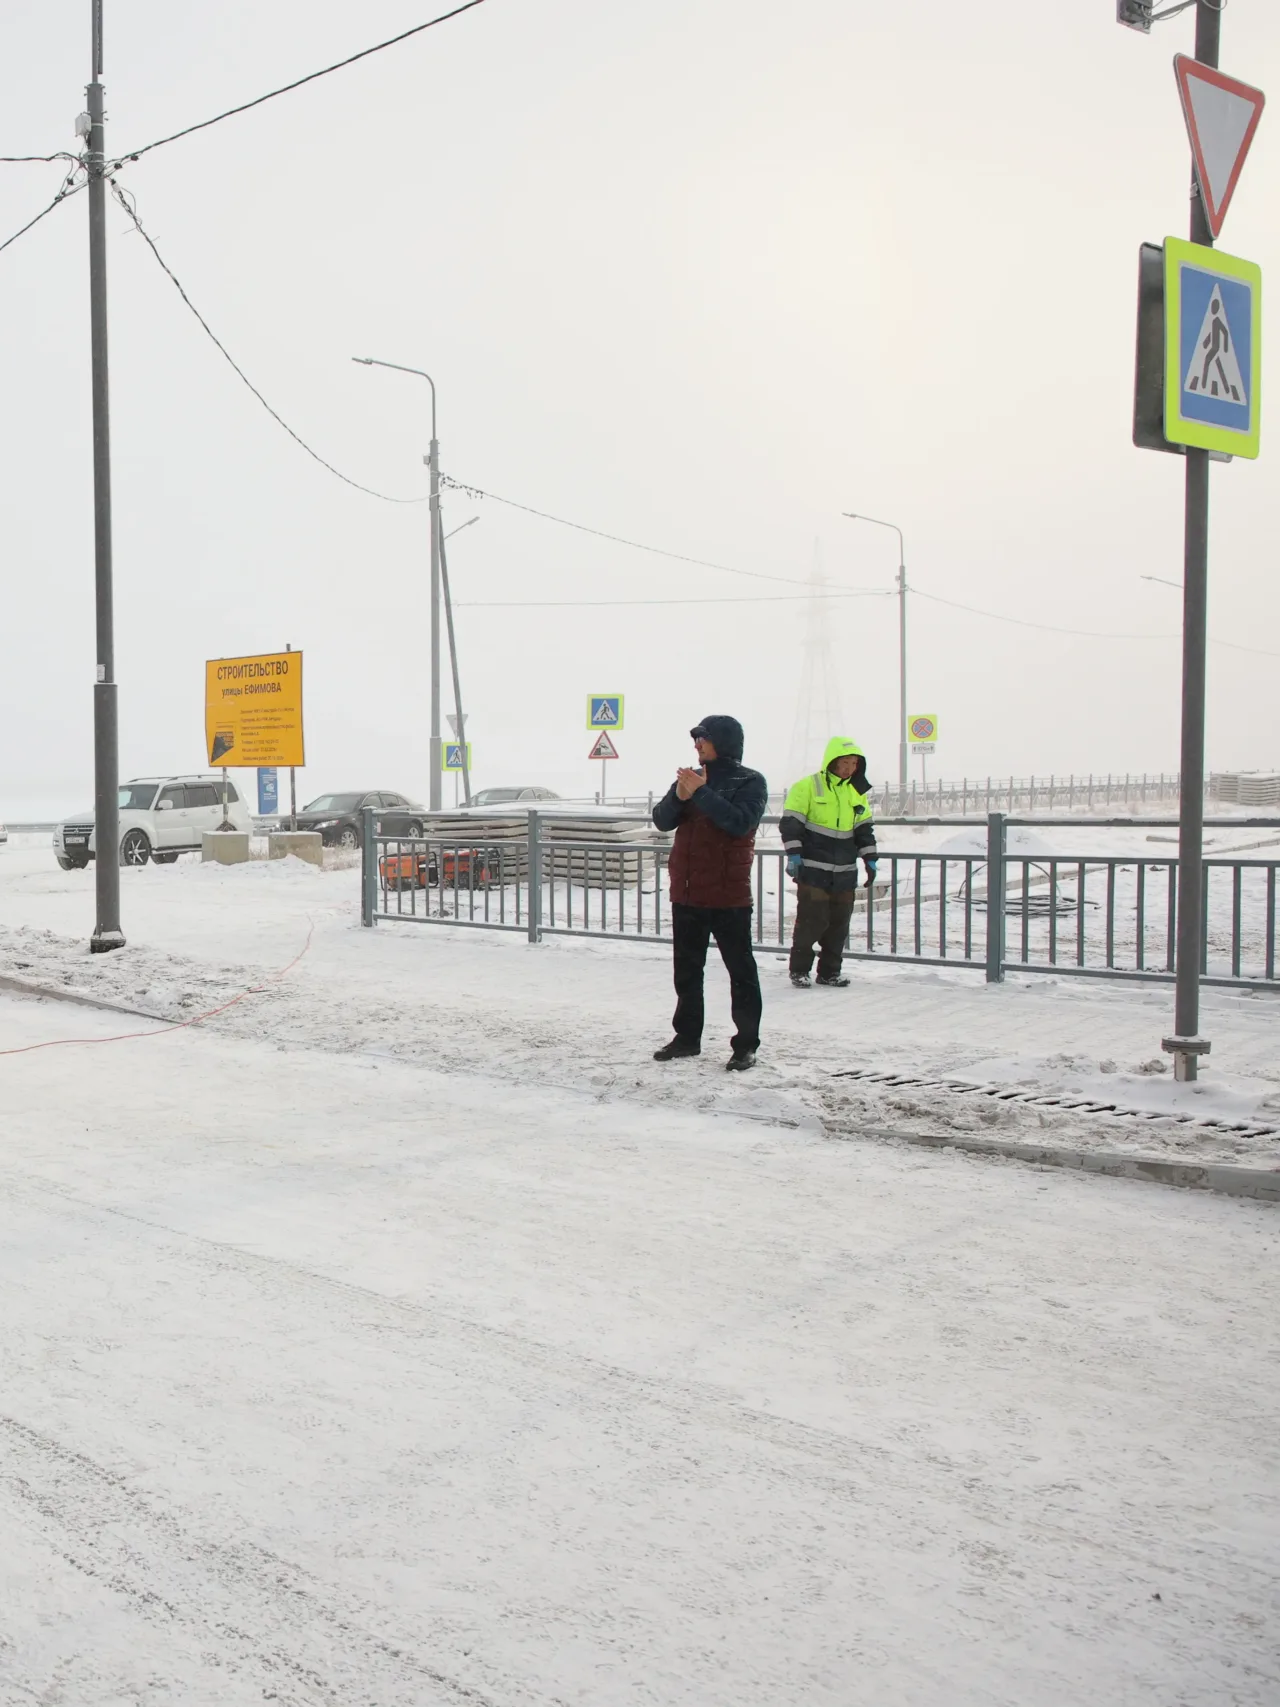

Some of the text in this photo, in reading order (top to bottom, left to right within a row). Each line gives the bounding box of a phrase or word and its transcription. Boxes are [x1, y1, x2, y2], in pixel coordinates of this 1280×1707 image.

[217, 660, 289, 680] СТРОИТЕЛЬСТВО
[222, 682, 282, 699] улицы ЕФИМОВА
